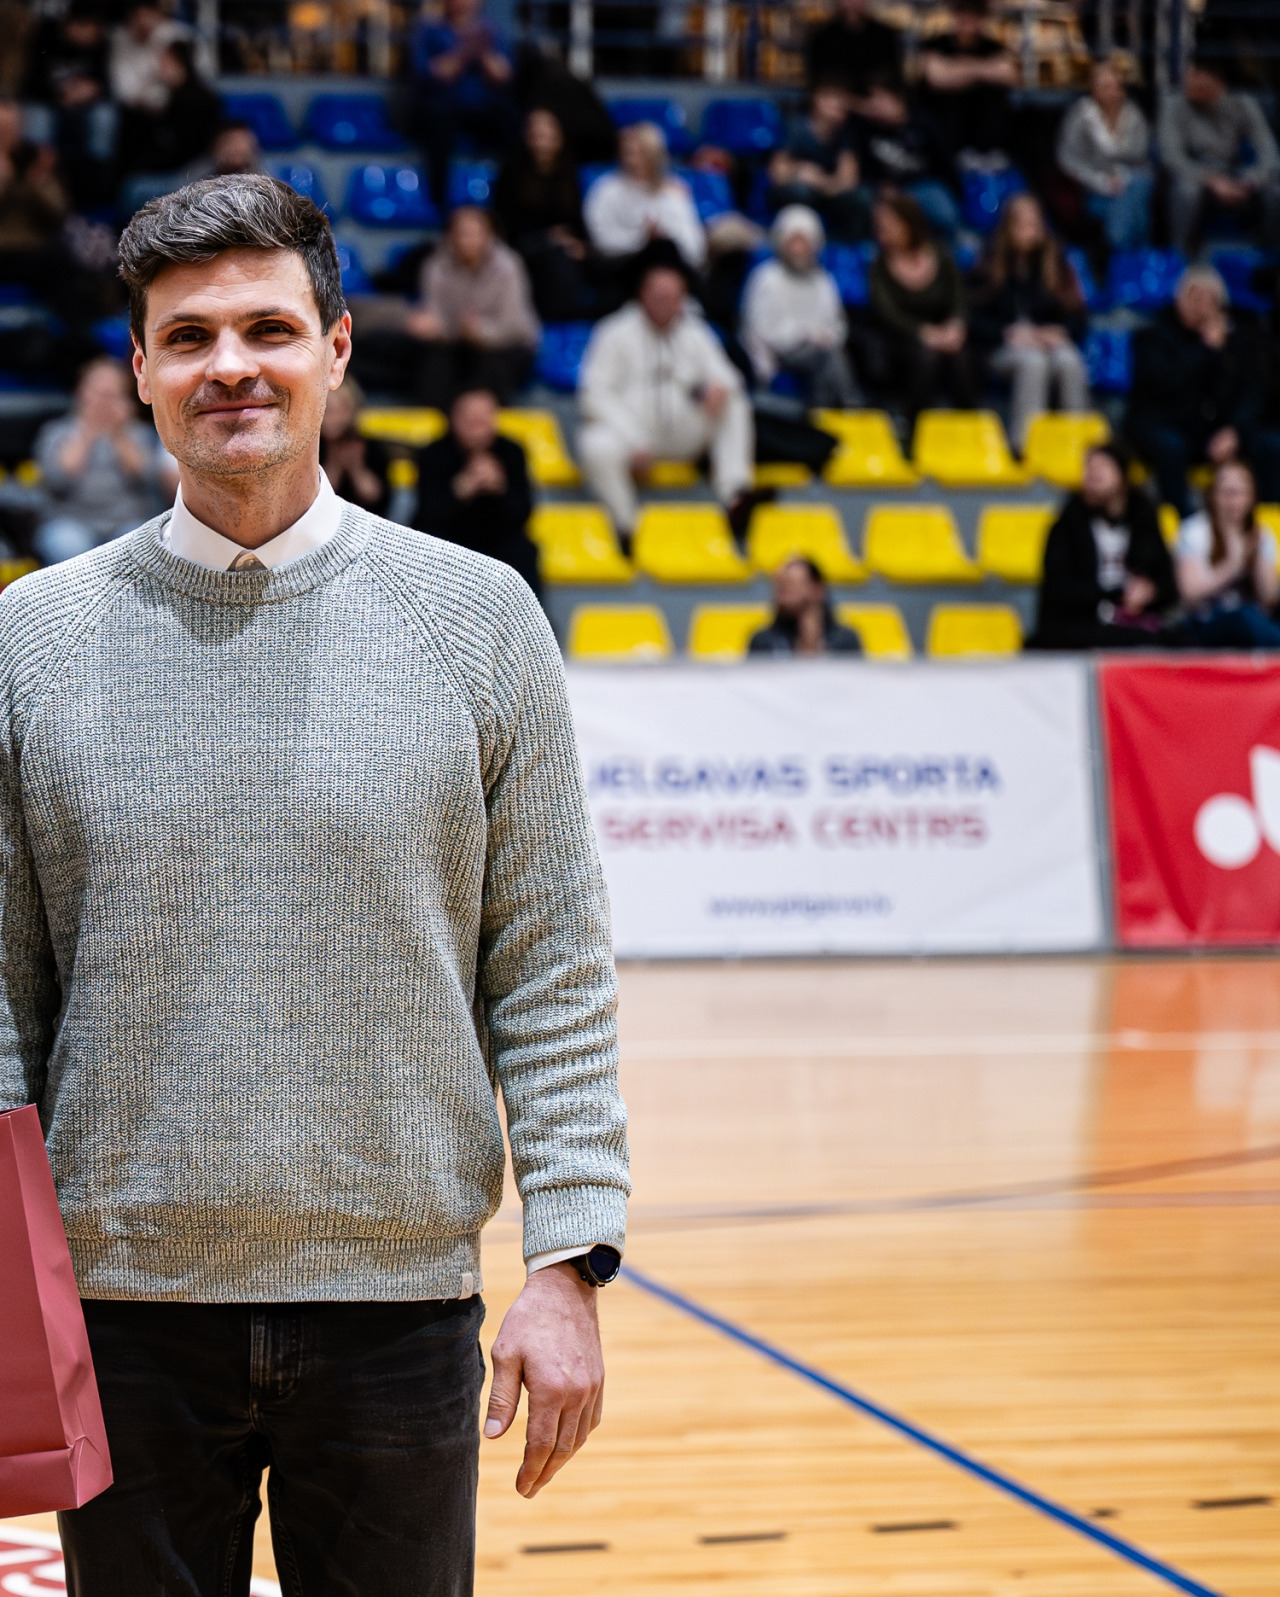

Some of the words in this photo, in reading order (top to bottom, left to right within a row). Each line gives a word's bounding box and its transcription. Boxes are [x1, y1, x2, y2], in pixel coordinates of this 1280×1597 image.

[825, 755, 1004, 796] SPORTA
[601, 811, 797, 850] SERVISA
[811, 806, 988, 850] CENTRS
